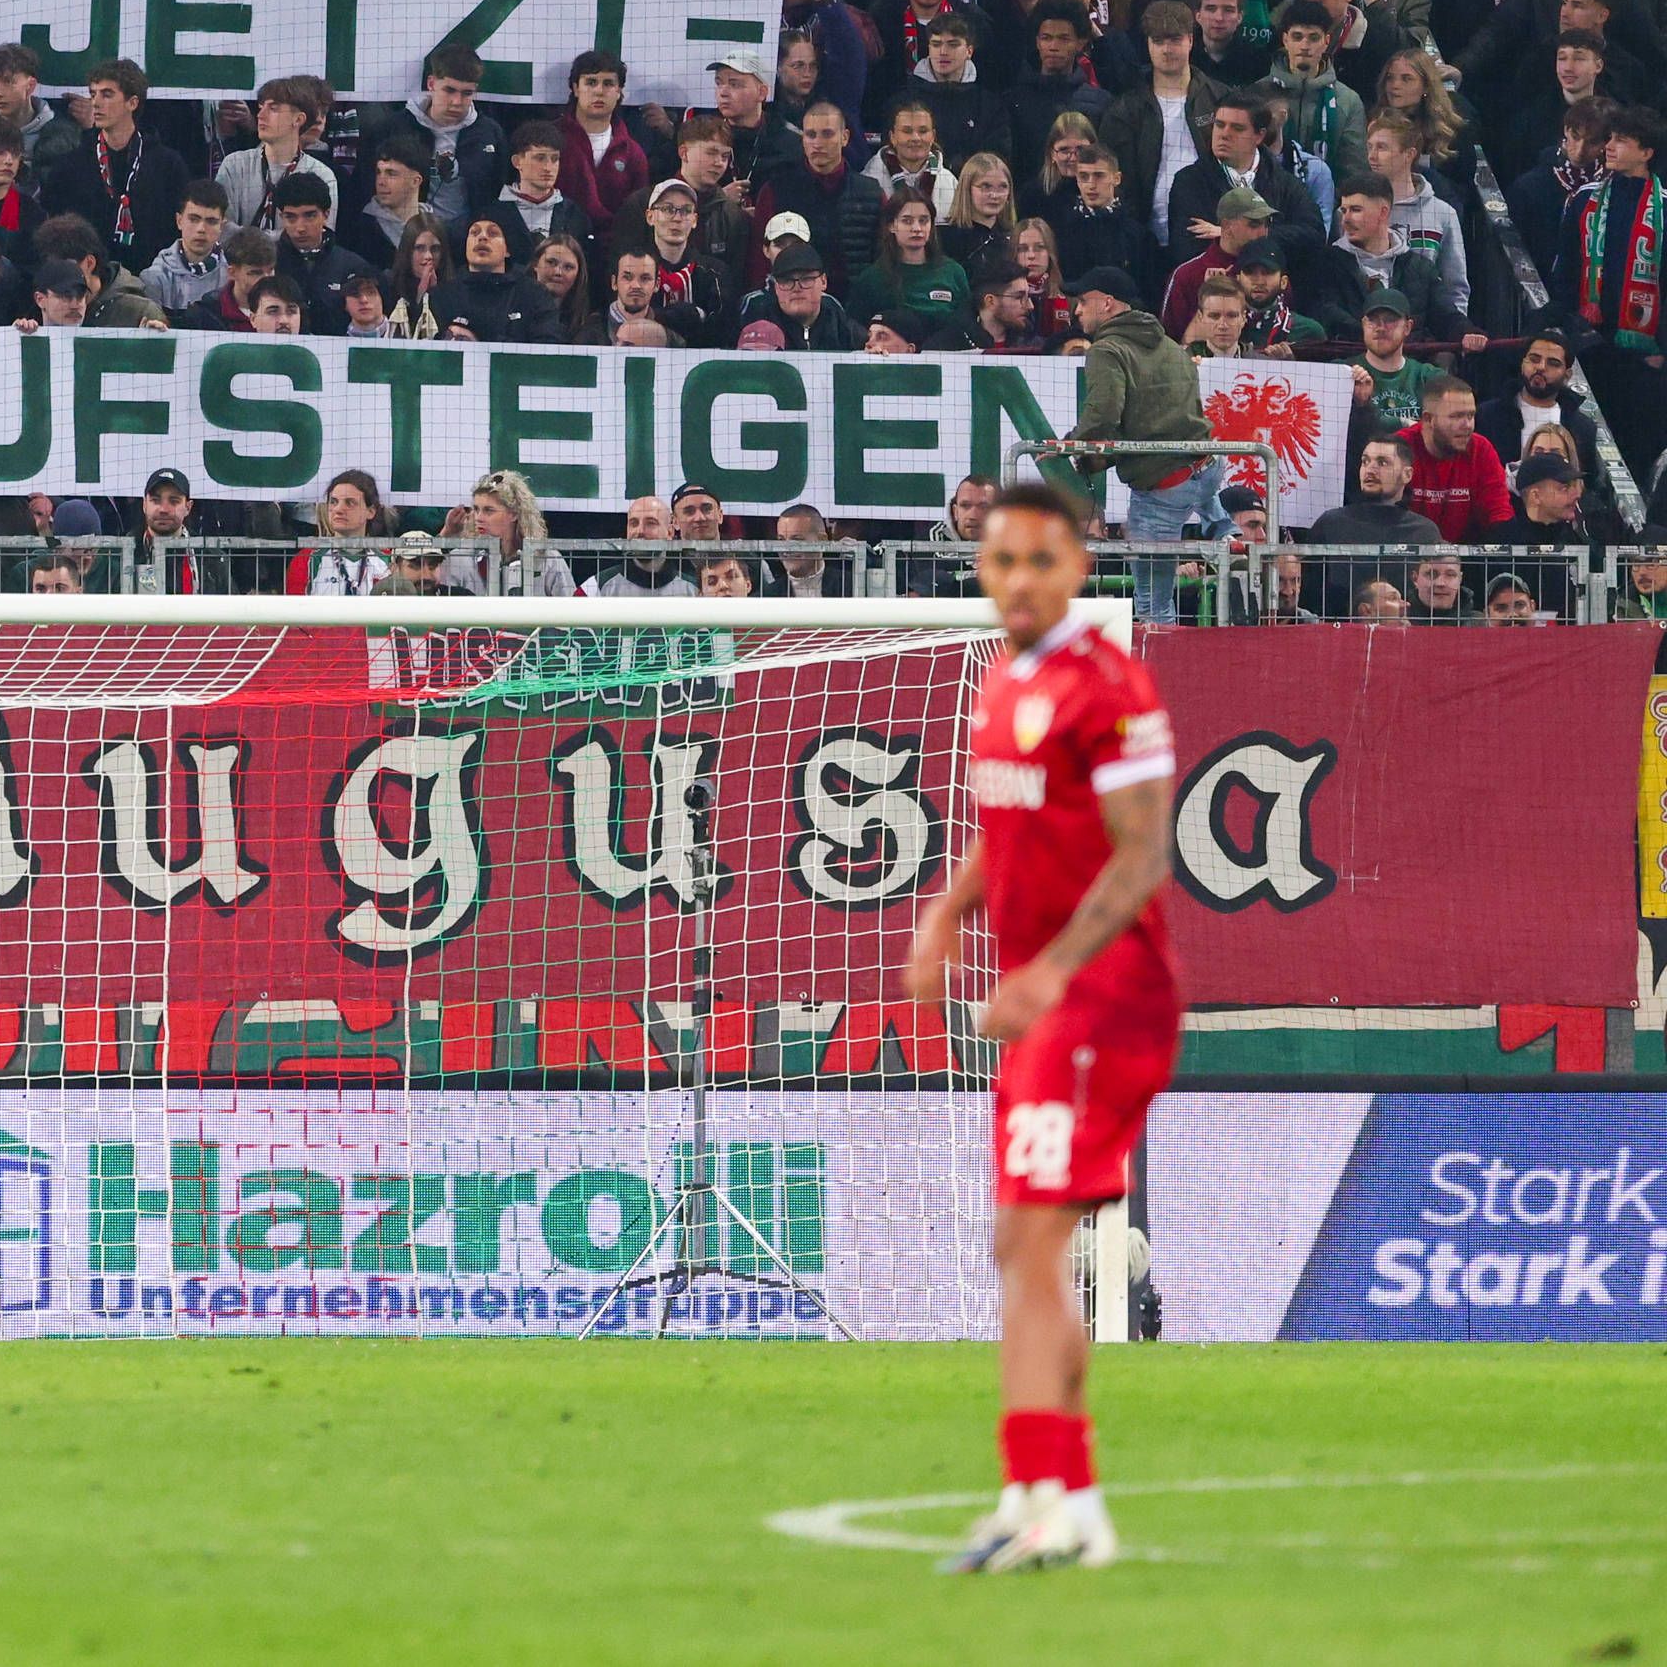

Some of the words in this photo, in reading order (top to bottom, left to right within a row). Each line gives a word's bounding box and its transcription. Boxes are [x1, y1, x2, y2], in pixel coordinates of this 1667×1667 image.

[1421, 1148, 1663, 1226] Stark
[90, 1276, 823, 1331] Unternehmensgruppe
[1368, 1235, 1617, 1306] Stark
